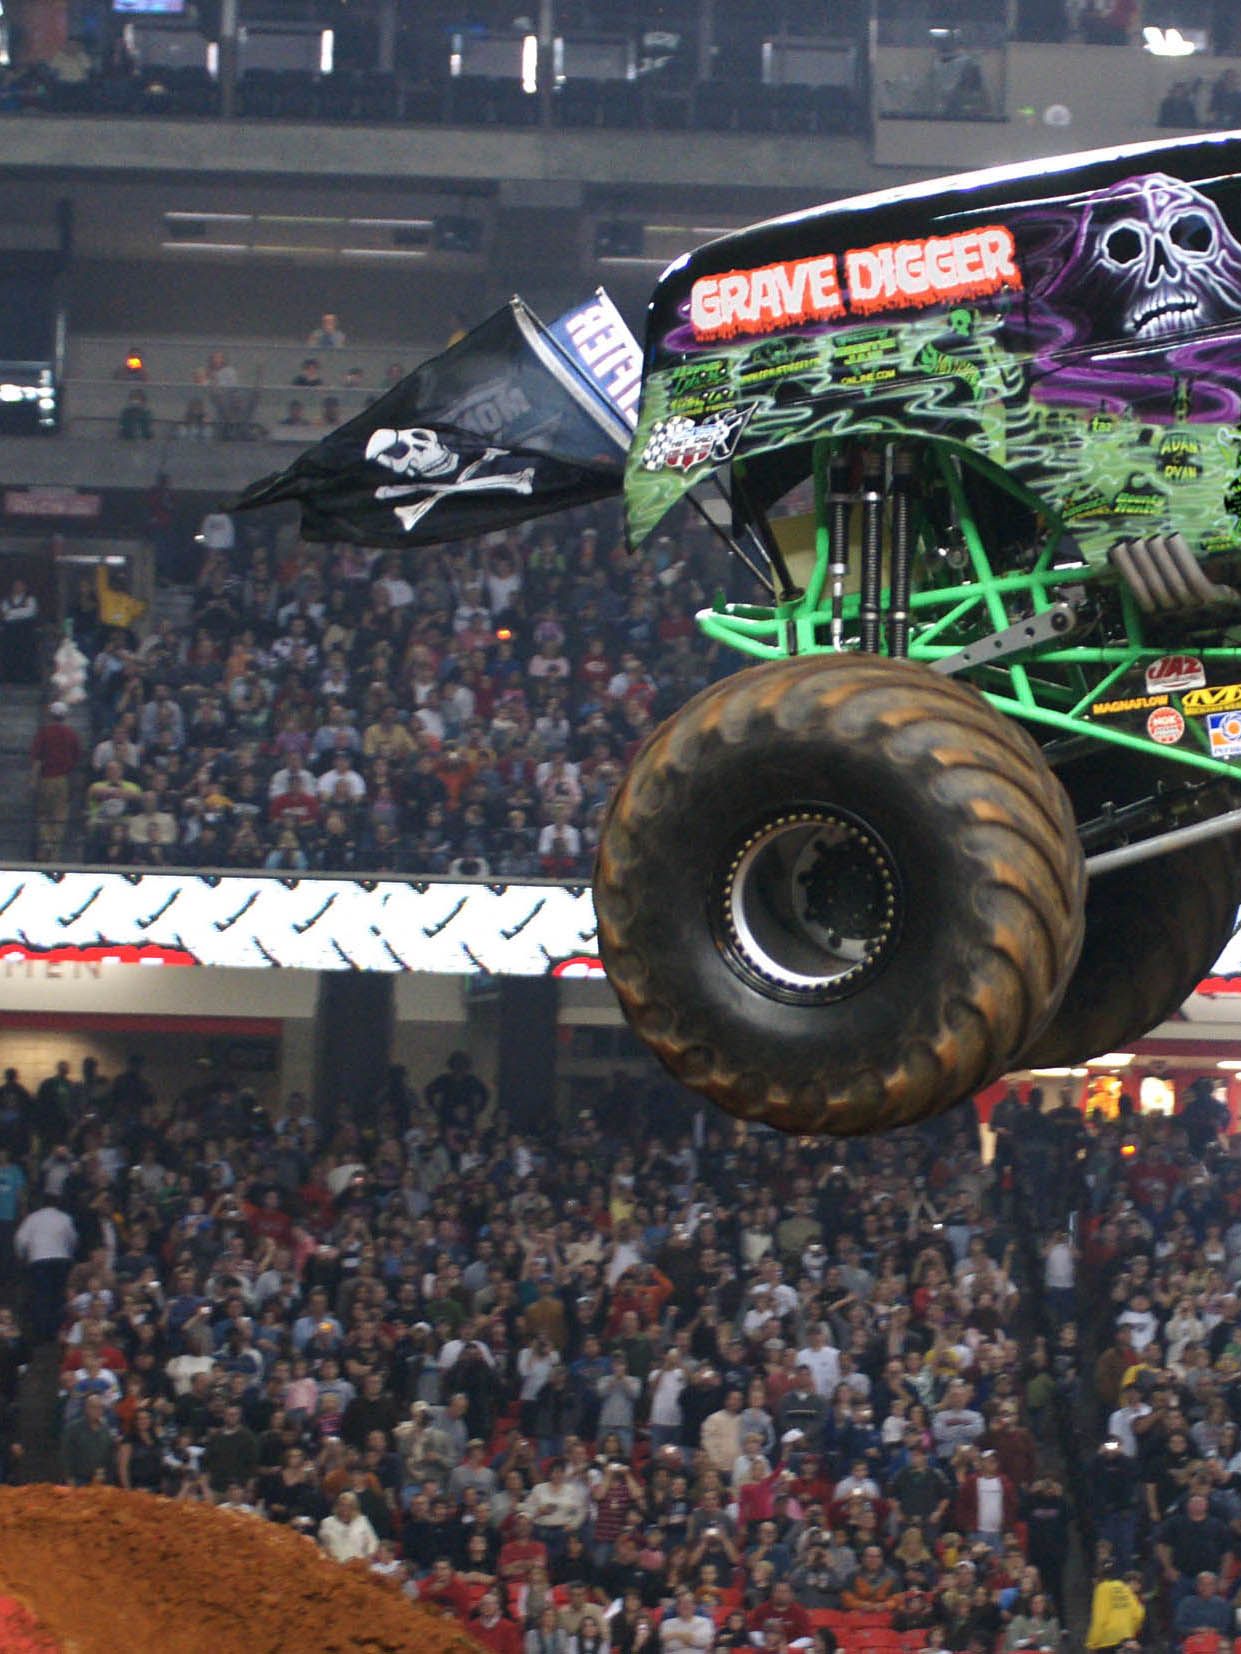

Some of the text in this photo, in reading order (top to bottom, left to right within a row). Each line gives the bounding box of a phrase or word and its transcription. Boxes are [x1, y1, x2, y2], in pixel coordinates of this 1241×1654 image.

[691, 229, 1016, 331] GRAVE DIGGER
[1147, 655, 1203, 680] JAZ
[1093, 694, 1169, 715] MAGNAFLOW
